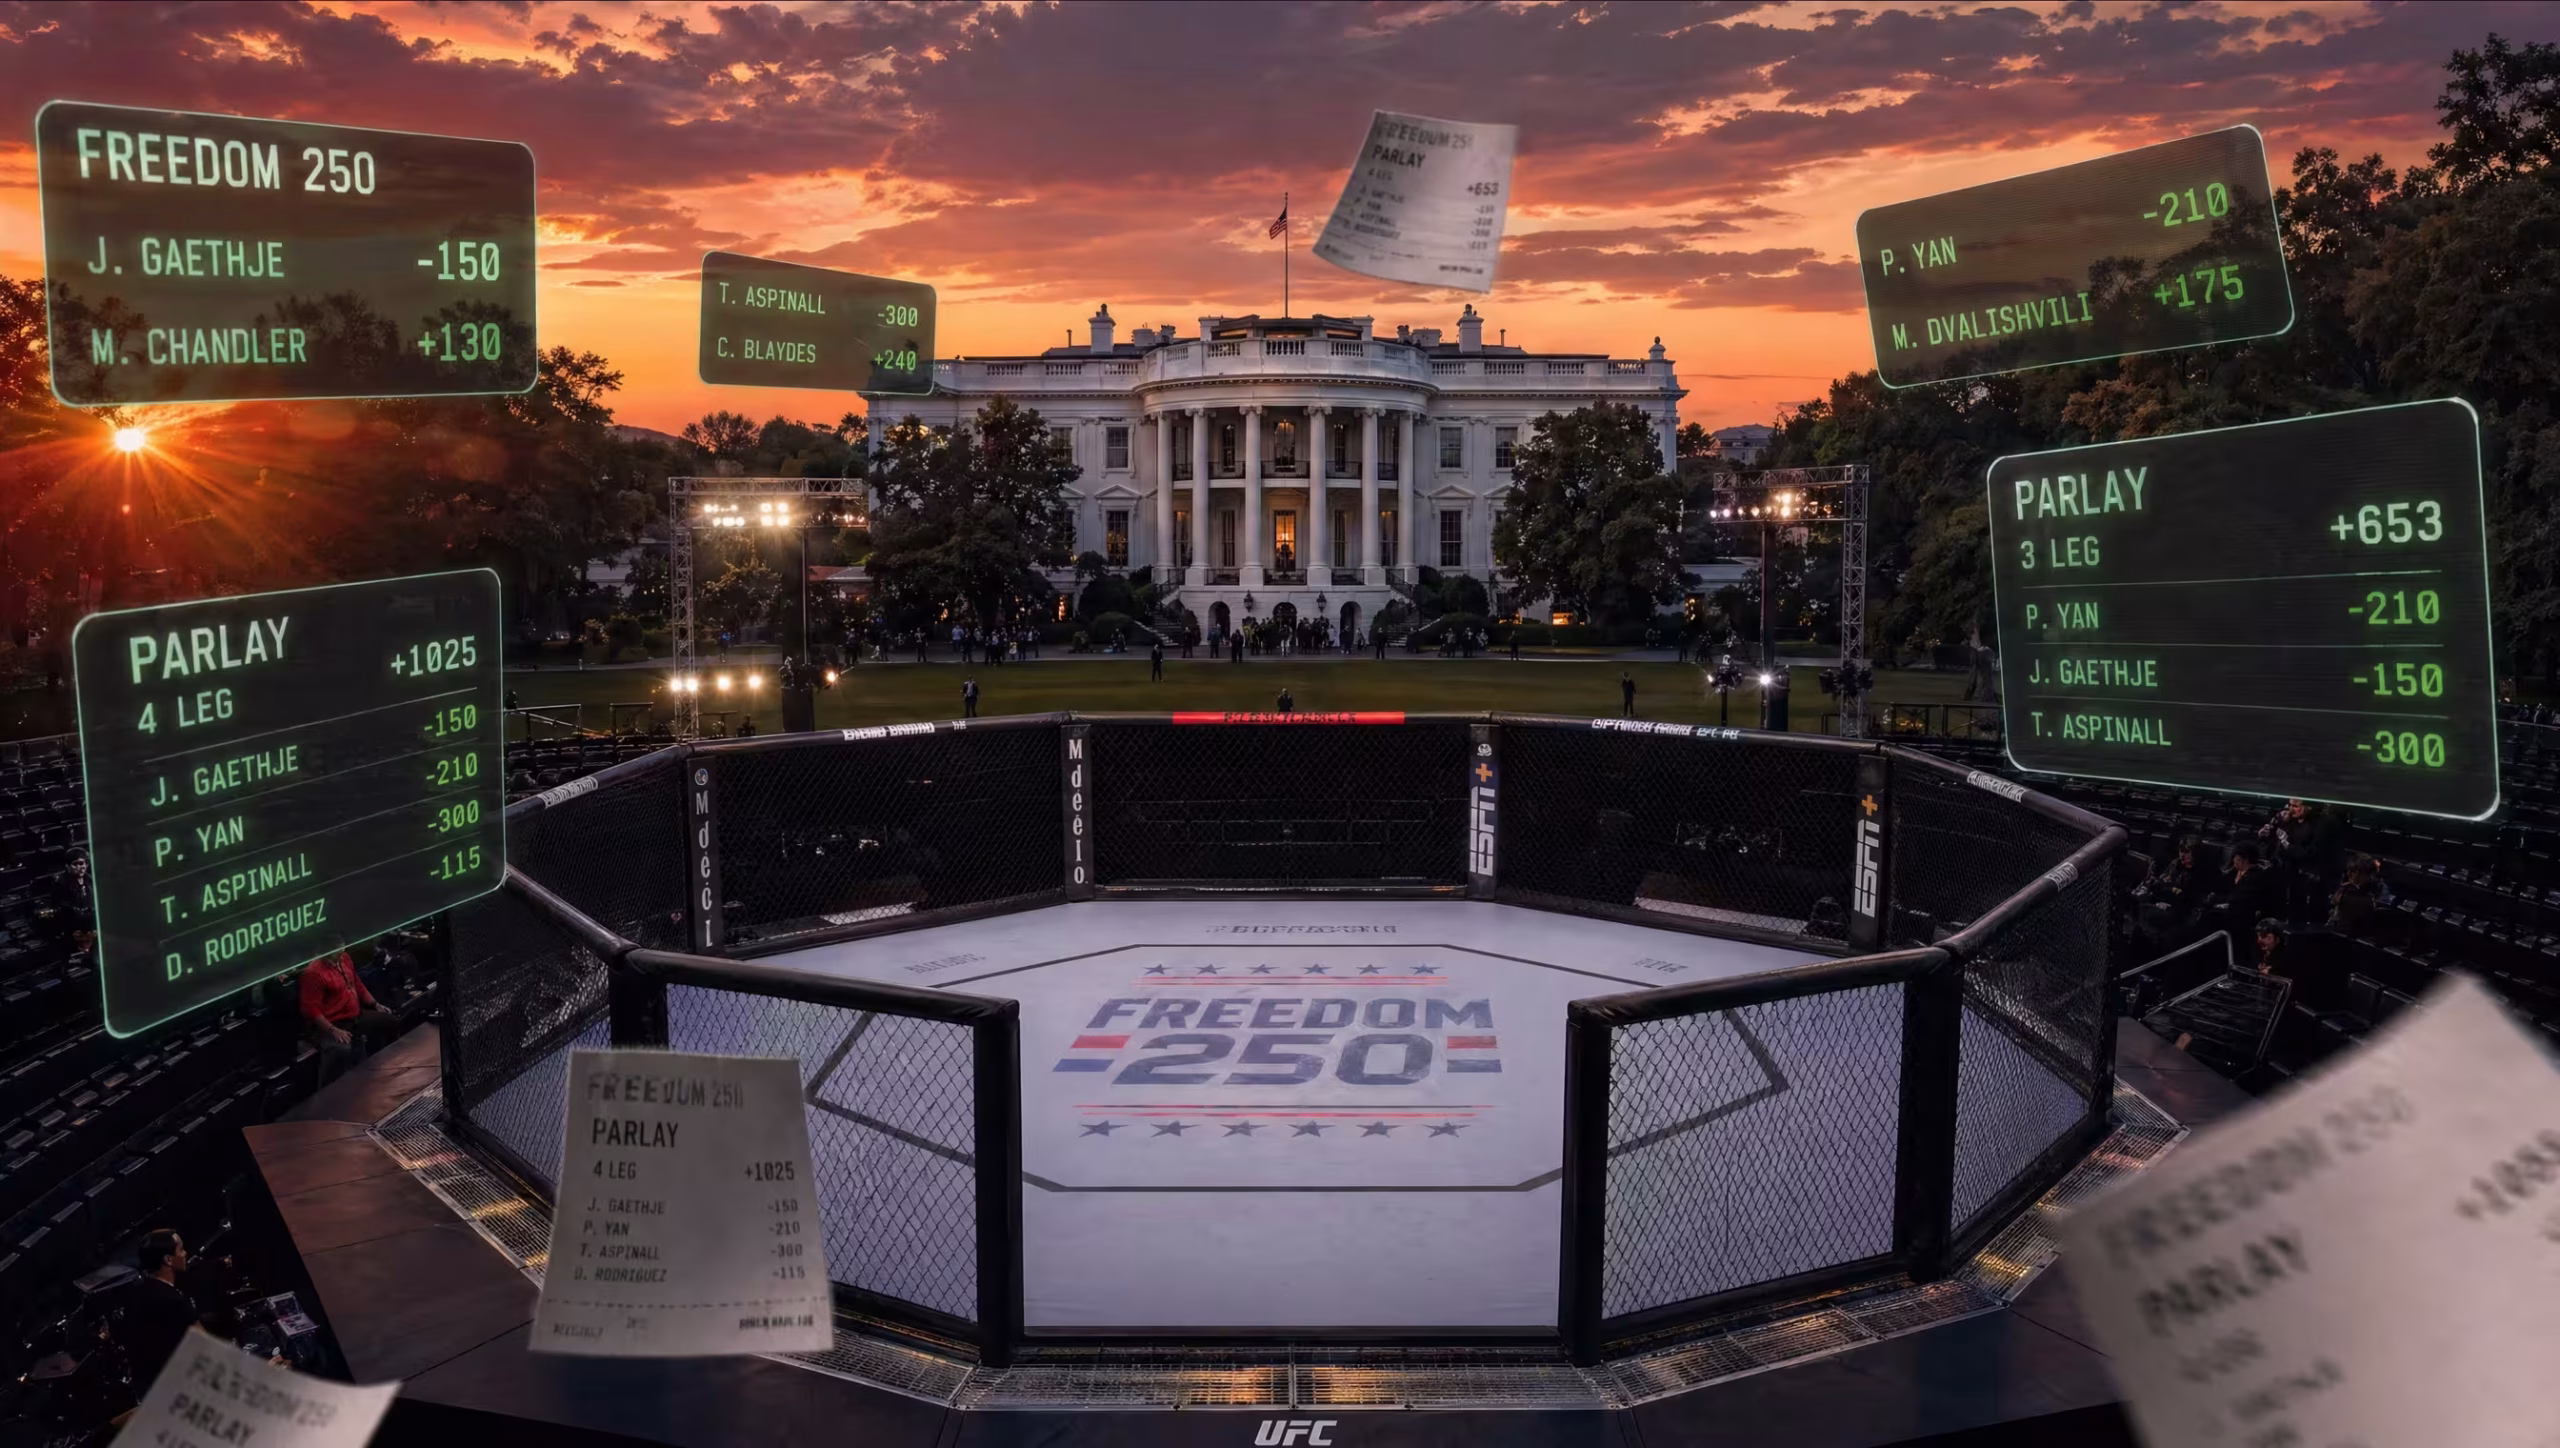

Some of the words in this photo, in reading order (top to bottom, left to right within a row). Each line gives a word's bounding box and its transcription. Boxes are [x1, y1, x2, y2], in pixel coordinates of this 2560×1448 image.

[76, 128, 281, 190] FREEDOM
[303, 147, 376, 195] 250
[1372, 144, 1426, 168] PARLAY
[1466, 182, 1499, 197] +653
[1881, 248, 1905, 276] P.
[1912, 236, 1957, 270] YAN
[2142, 182, 2228, 227] -210
[88, 236, 123, 275] J.
[142, 237, 285, 278] GAETHJE
[417, 241, 500, 282] -150
[719, 282, 736, 304] T.
[745, 286, 826, 314] ASPINALL
[877, 305, 918, 327] -300
[1892, 323, 1918, 352] M.
[1927, 291, 2093, 347] DVALISHVILI
[2155, 264, 2244, 308] +175
[91, 328, 129, 366] M.
[148, 327, 307, 365] CHANDLER
[417, 322, 502, 362] +130
[718, 336, 735, 358] C.
[744, 339, 816, 364] BLAYDES
[874, 350, 916, 371] +240
[2015, 466, 2149, 521] PARLAY
[2330, 500, 2443, 545] +653
[2021, 540, 2036, 569] 3
[2051, 536, 2100, 567] LEG
[2026, 603, 2048, 630] P.
[2057, 602, 2100, 629] YAN
[2349, 589, 2440, 625] -210
[129, 616, 290, 685] PARLAY
[390, 635, 478, 678] +1025
[2029, 660, 2051, 685] J.
[2059, 658, 2159, 687] GAETHJE
[2353, 662, 2444, 698] -150
[138, 703, 158, 735] 4
[178, 688, 234, 728] LEG
[150, 777, 180, 807] J.
[193, 745, 300, 797] GAETHJE
[423, 704, 477, 739] -150
[2031, 712, 2053, 737] T.
[2062, 715, 2173, 747] ASPINALL
[2356, 730, 2446, 768] -300
[155, 837, 184, 867] P.
[196, 816, 245, 854] YAN
[425, 752, 478, 787] -210
[160, 896, 188, 924] T.
[201, 853, 312, 913] ASPINALL
[427, 800, 480, 834] -300
[166, 952, 194, 982] D.
[205, 898, 328, 967] RODRIGUEZ
[429, 846, 482, 881] -115
[1085, 997, 1494, 1030] FREEDOM
[1112, 1033, 1434, 1085] 250
[592, 1118, 679, 1148] PARLAY
[593, 1160, 603, 1178] 4
[609, 1162, 636, 1180] LEG
[744, 1161, 795, 1181] +1025
[583, 1221, 597, 1235] P.
[605, 1221, 630, 1236] YAN
[769, 1221, 800, 1235] -210
[587, 1199, 601, 1212] J.
[608, 1199, 665, 1215] GAETHJE
[766, 1199, 798, 1213] -150
[580, 1243, 593, 1258] T.
[600, 1244, 661, 1259] ASPINALL
[770, 1244, 803, 1258] -300
[168, 1392, 255, 1446] PARLAY
[1254, 1420, 1337, 1446] UFC
